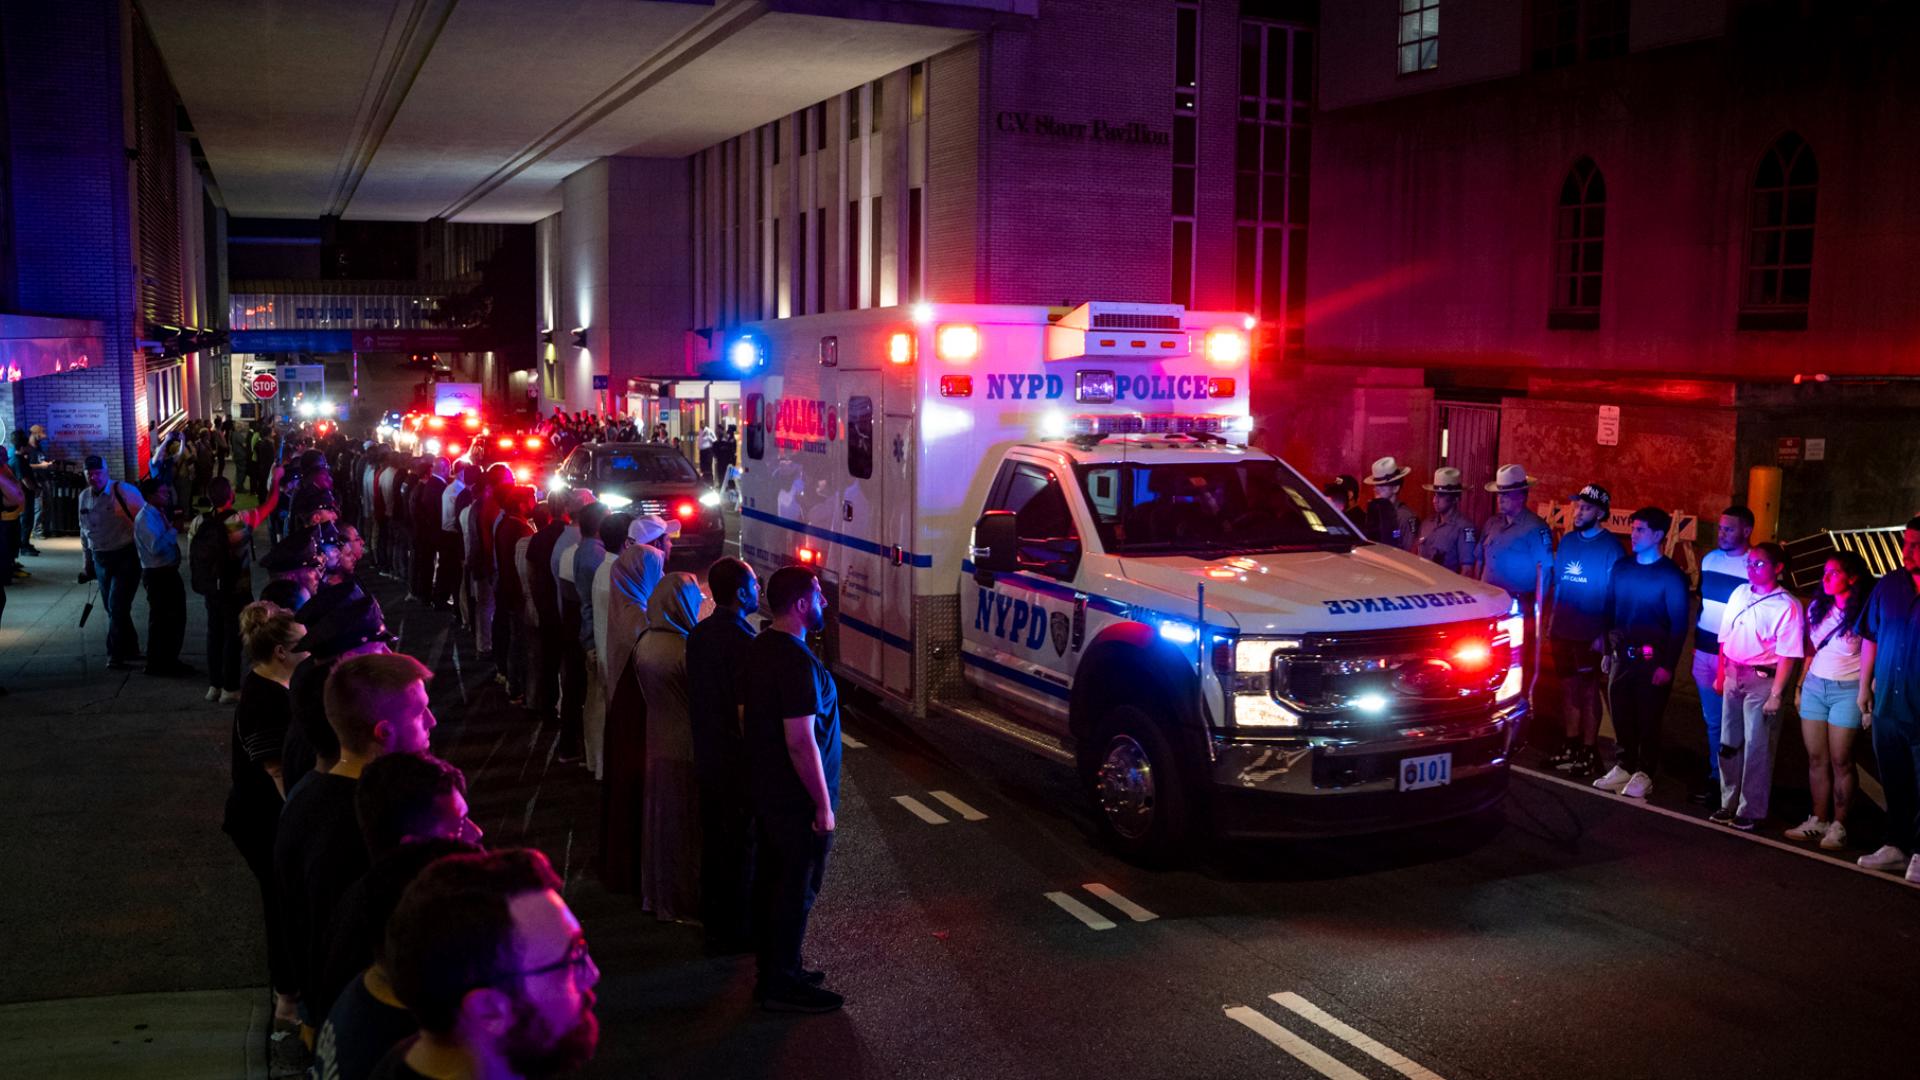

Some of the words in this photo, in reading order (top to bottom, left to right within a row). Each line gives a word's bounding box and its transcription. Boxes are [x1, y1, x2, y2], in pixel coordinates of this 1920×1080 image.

[1035, 115, 1087, 136] Starr
[1093, 119, 1171, 145] Pavilion
[254, 381, 277, 391] STOP
[987, 374, 1063, 399] NYPD
[1115, 375, 1208, 400] POLICE
[775, 399, 826, 436] POLICE
[1612, 515, 1633, 527] NYP
[975, 587, 1048, 650] NYPD
